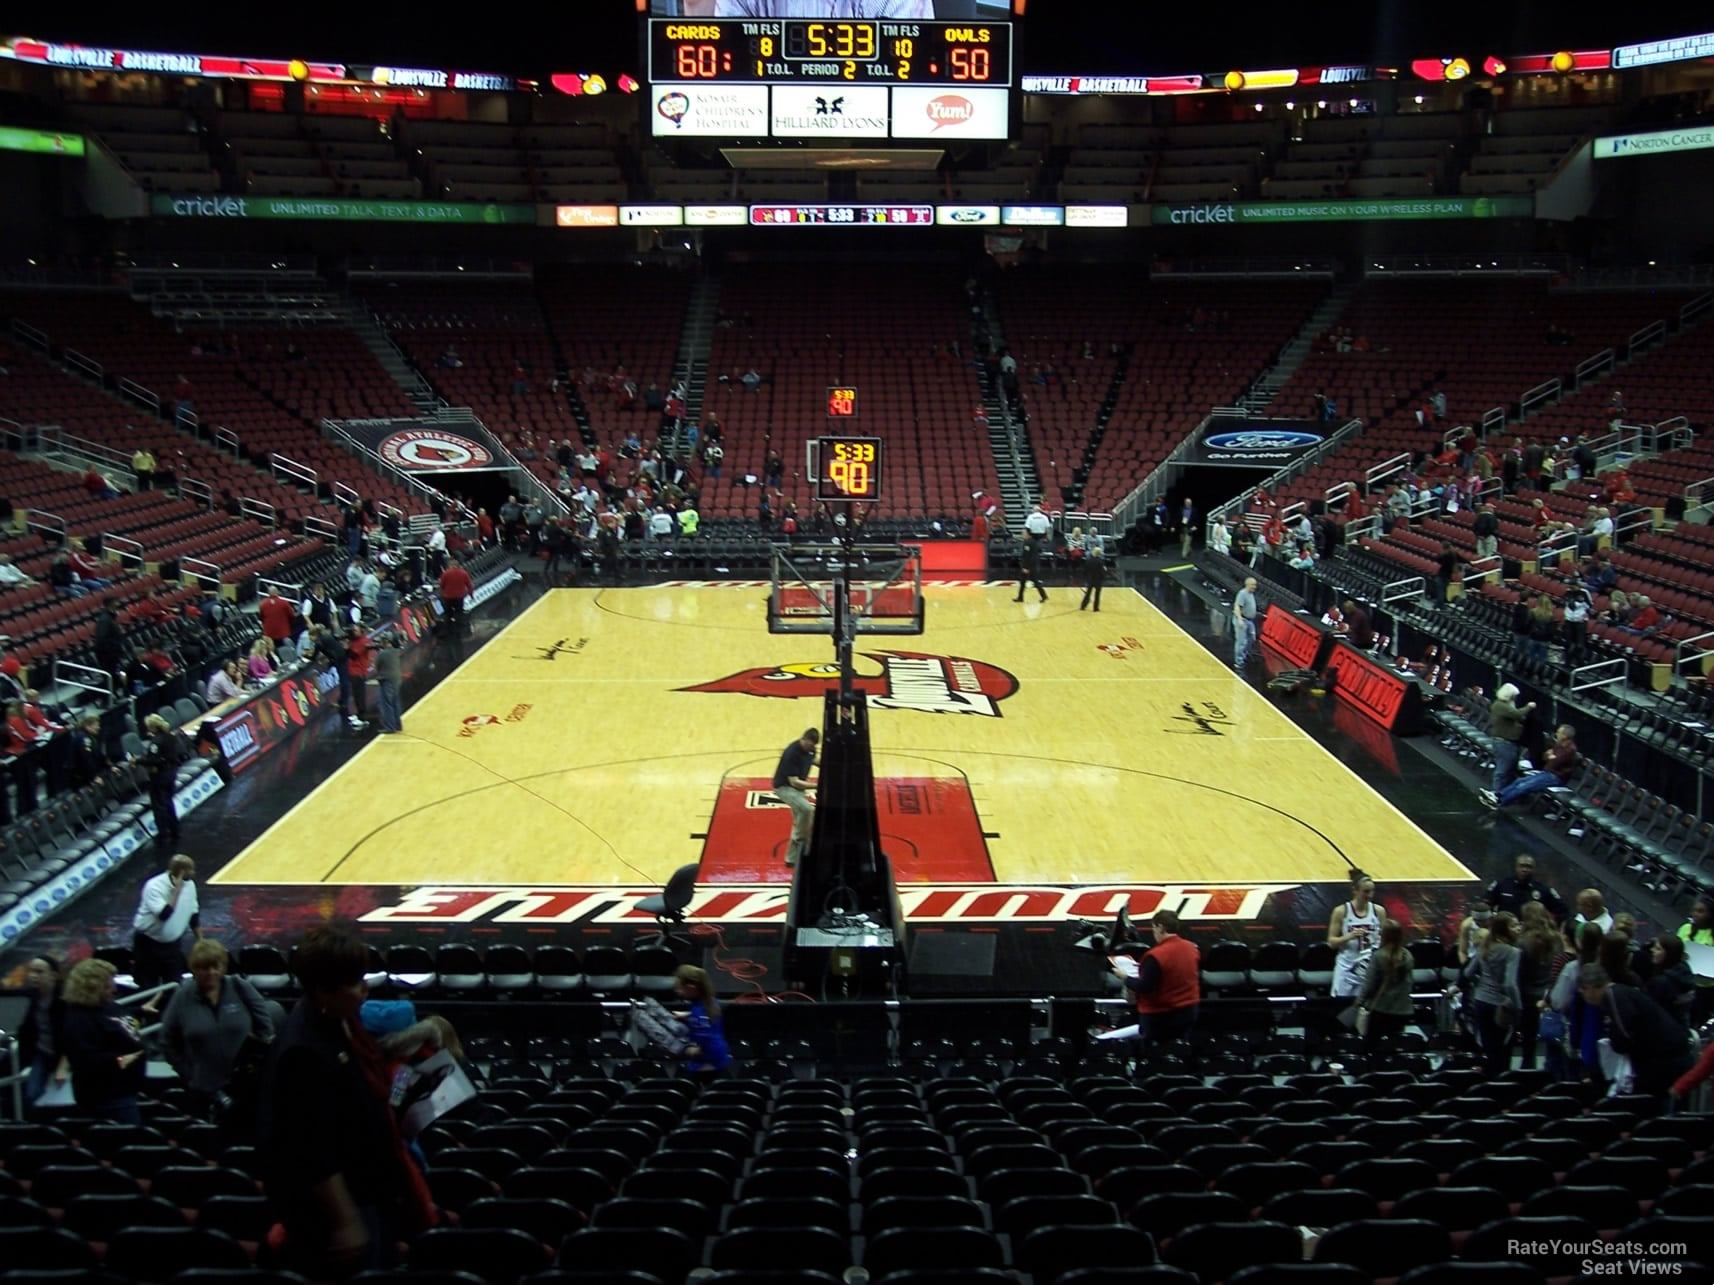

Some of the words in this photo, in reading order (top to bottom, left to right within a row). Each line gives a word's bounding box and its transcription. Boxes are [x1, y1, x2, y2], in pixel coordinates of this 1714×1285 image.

[666, 25, 721, 40] CARDS
[742, 23, 758, 35] TM
[760, 24, 780, 36] FLS
[882, 25, 898, 37] TM
[901, 25, 920, 37] FLS
[945, 28, 990, 43] OWLS
[760, 37, 774, 57] 8
[808, 24, 874, 57] 5:33
[894, 39, 913, 58] 10
[48, 44, 114, 67] LOUISVILLE
[123, 51, 201, 72] BASKETBALL
[678, 46, 717, 77] 60
[951, 48, 989, 80] 50
[766, 63, 794, 75] T.O.L.
[801, 63, 839, 75] PERIOD
[843, 60, 856, 80] 2
[866, 64, 893, 76] T.O.L.
[898, 60, 911, 80] 2
[389, 68, 448, 87] LOUISVILLE
[454, 73, 514, 90] BASKETBA
[1078, 77, 1147, 93] BASKETBALL
[930, 101, 971, 120] Yum!
[775, 117, 838, 129] HILLIARD
[843, 117, 886, 129] LYONS
[1630, 138, 1669, 150] NORTON
[1672, 133, 1713, 146] CANCER
[173, 197, 248, 217] cricket
[270, 203, 339, 215] UNLIMITED
[427, 206, 462, 218] DATA
[1170, 204, 1235, 224] cricket
[1243, 207, 1295, 217] UNLIMITED
[1297, 206, 1329, 216] MUSIC
[1330, 206, 1347, 215] ON
[1350, 205, 1377, 215] YOUR
[1380, 204, 1432, 214] WIRELESS
[1434, 203, 1463, 213] PLAN
[406, 431, 474, 449] ATHLETIC
[1224, 433, 1300, 448] Ford
[834, 443, 874, 462] 5:33
[865, 656, 997, 717] LOUISVILLE
